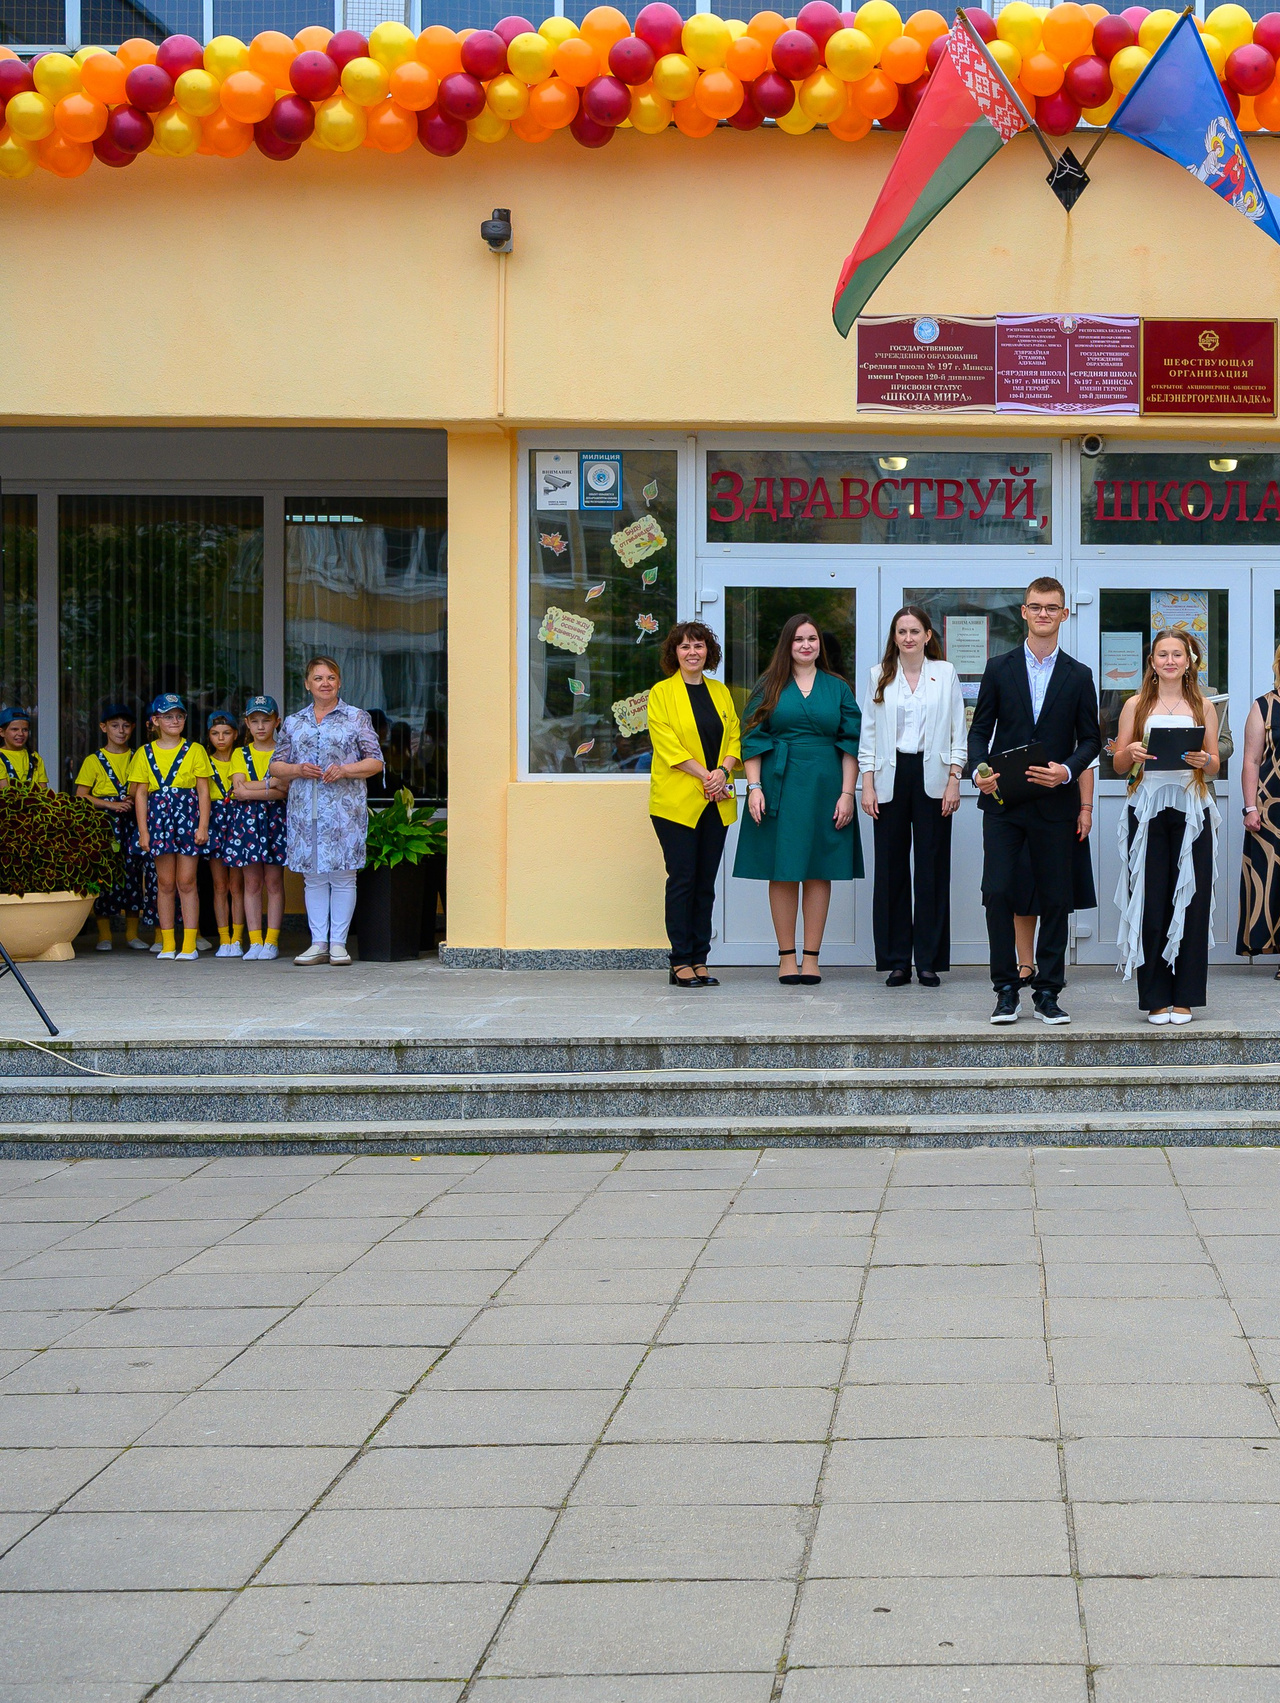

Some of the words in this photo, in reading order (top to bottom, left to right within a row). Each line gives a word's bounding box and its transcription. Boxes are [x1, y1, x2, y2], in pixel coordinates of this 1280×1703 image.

[859, 362, 897, 370] «Средняя
[962, 363, 993, 371] Минска
[1163, 358, 1254, 368] ШЕФСТВУЮЩАЯ
[895, 373, 923, 381] Героев
[1169, 369, 1248, 379] ОРГАНИЗАЦИЯ
[880, 392, 931, 401] «ШКОЛА
[933, 392, 972, 402] МИРА»
[1146, 394, 1271, 404] «БЕЛЭНЕРГОРЕМНАЛАДКА»
[710, 466, 1049, 529] ЗДРАВСТВУЙ,
[624, 524, 642, 536] Буду
